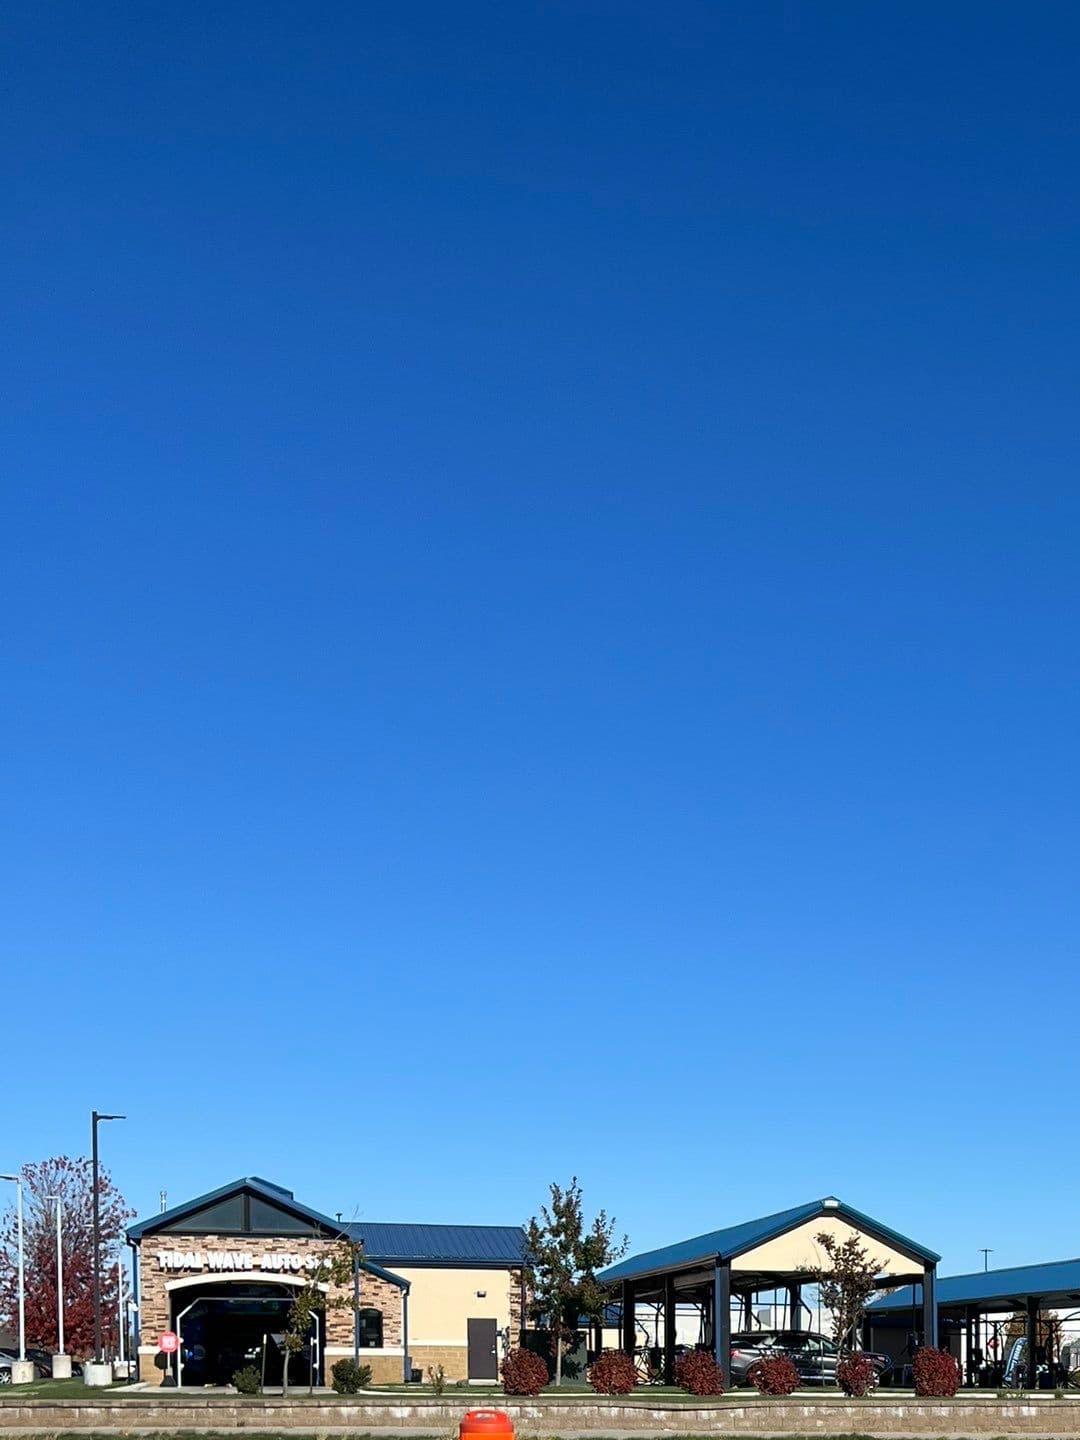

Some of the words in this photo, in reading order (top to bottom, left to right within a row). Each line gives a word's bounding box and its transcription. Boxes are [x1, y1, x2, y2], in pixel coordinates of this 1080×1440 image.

[157, 1251, 203, 1269] TIDAL
[207, 1251, 254, 1269] WAVE
[261, 1253, 304, 1270] AUTO
